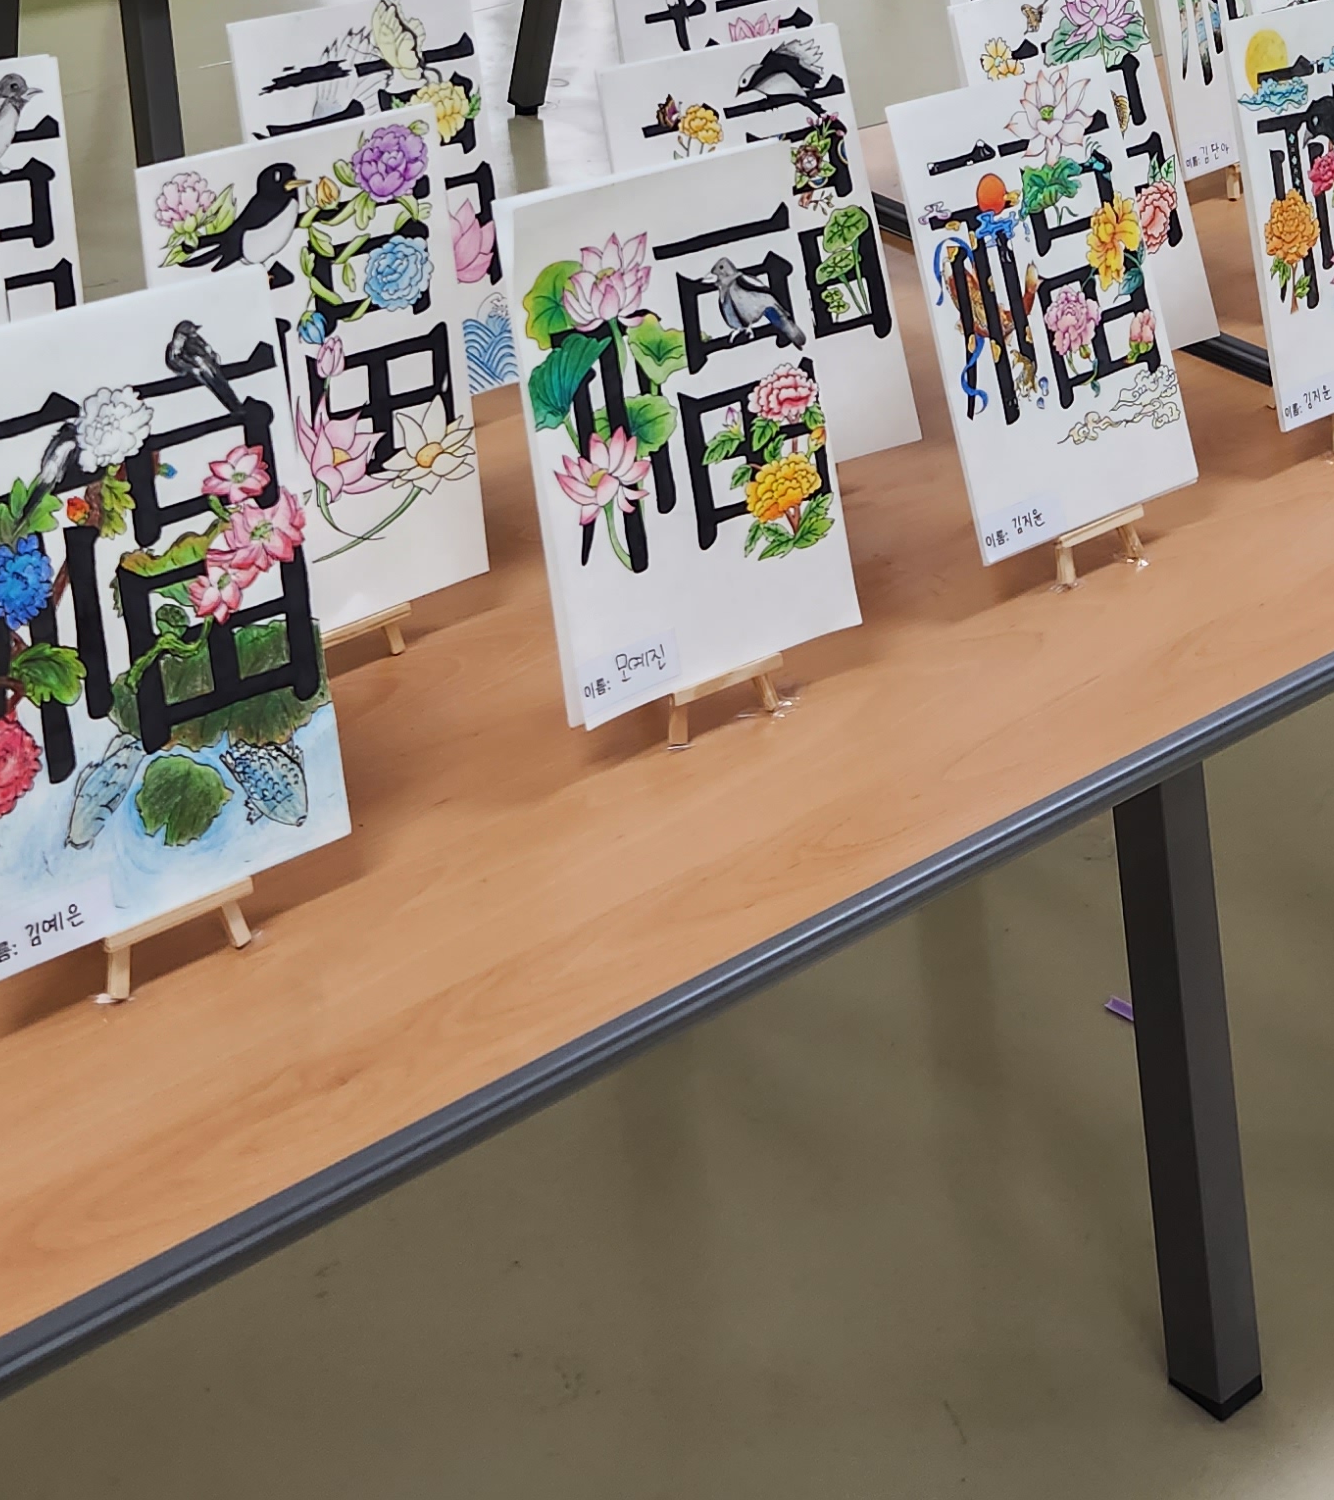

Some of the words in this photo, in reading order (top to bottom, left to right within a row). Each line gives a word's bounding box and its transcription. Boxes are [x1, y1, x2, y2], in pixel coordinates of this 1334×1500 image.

[1284, 402, 1303, 419] 이름:
[985, 528, 1010, 549] 이름:
[584, 677, 612, 700] 이름:
[24, 903, 85, 947] 김예은
